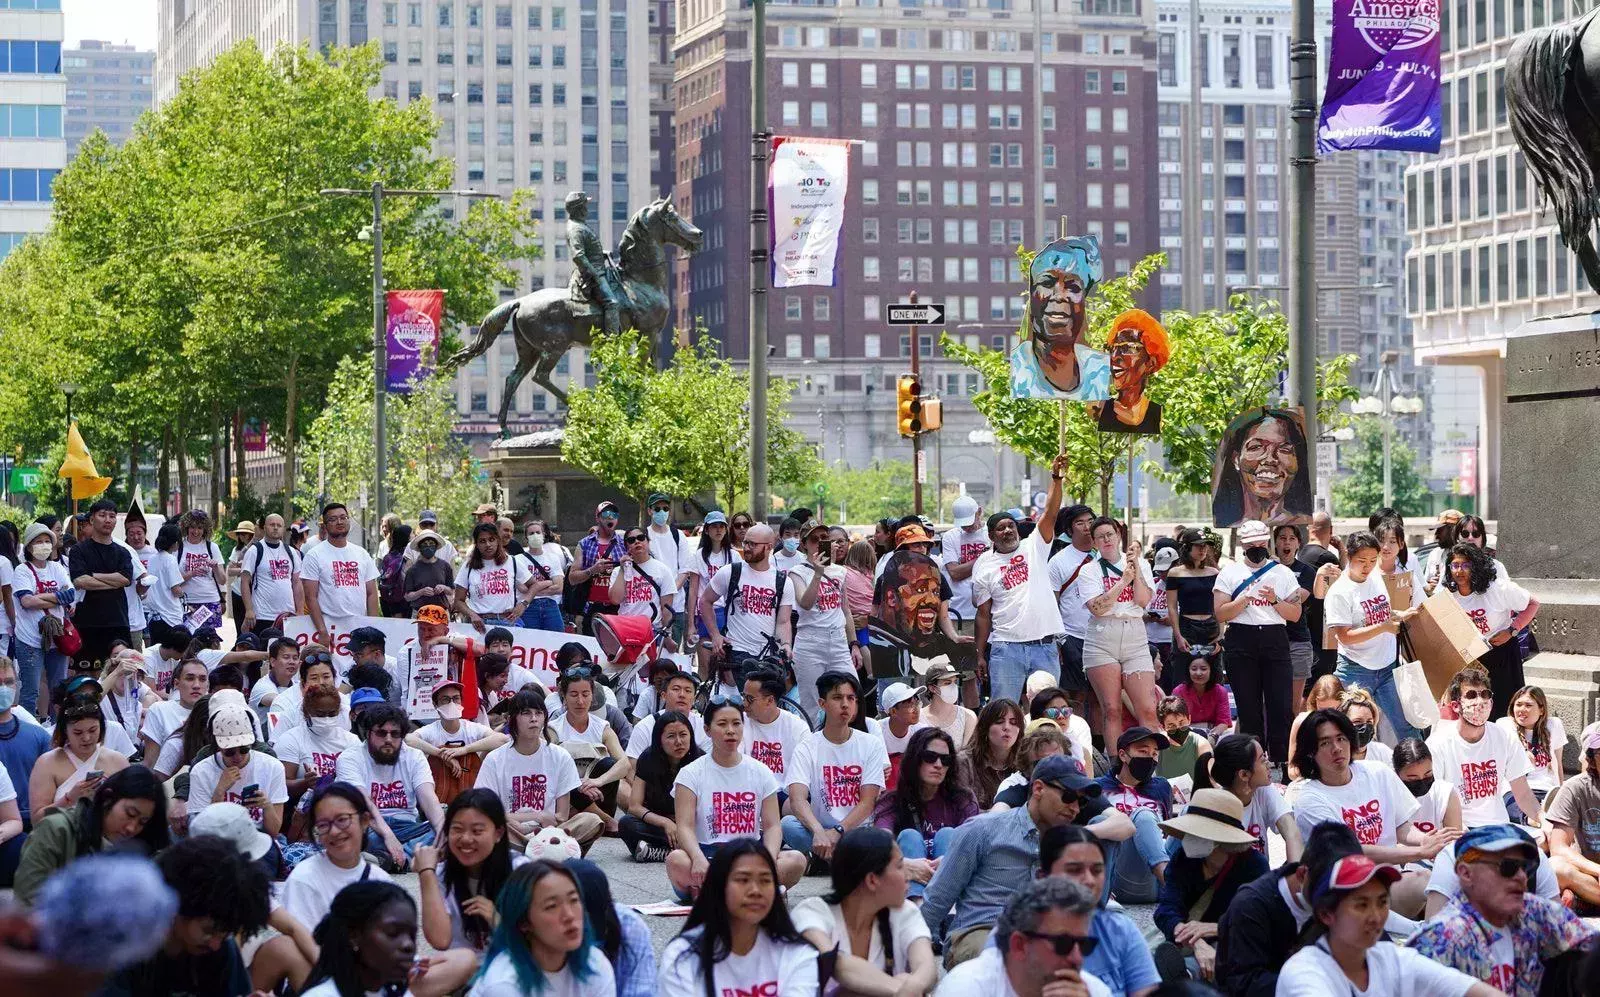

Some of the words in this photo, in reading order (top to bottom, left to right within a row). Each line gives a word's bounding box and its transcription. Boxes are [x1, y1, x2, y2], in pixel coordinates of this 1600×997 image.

[1348, 0, 1439, 20] America
[894, 311, 910, 319] ONE
[912, 311, 928, 319] WAY
[967, 543, 986, 551] NO
[487, 581, 509, 589] CHINA
[751, 586, 776, 597] NO
[1368, 595, 1386, 606] NO
[749, 608, 773, 616] TOWN
[497, 690, 516, 699] NO
[760, 741, 782, 750] NO
[832, 765, 862, 776] NO
[522, 774, 547, 784] NO
[832, 784, 861, 797] CHINA
[723, 792, 756, 803] NO
[833, 796, 861, 807] TOWN
[379, 799, 408, 809] CHINA
[1349, 799, 1379, 817] NO
[723, 811, 755, 823] CHINA
[723, 823, 755, 834] TOWN
